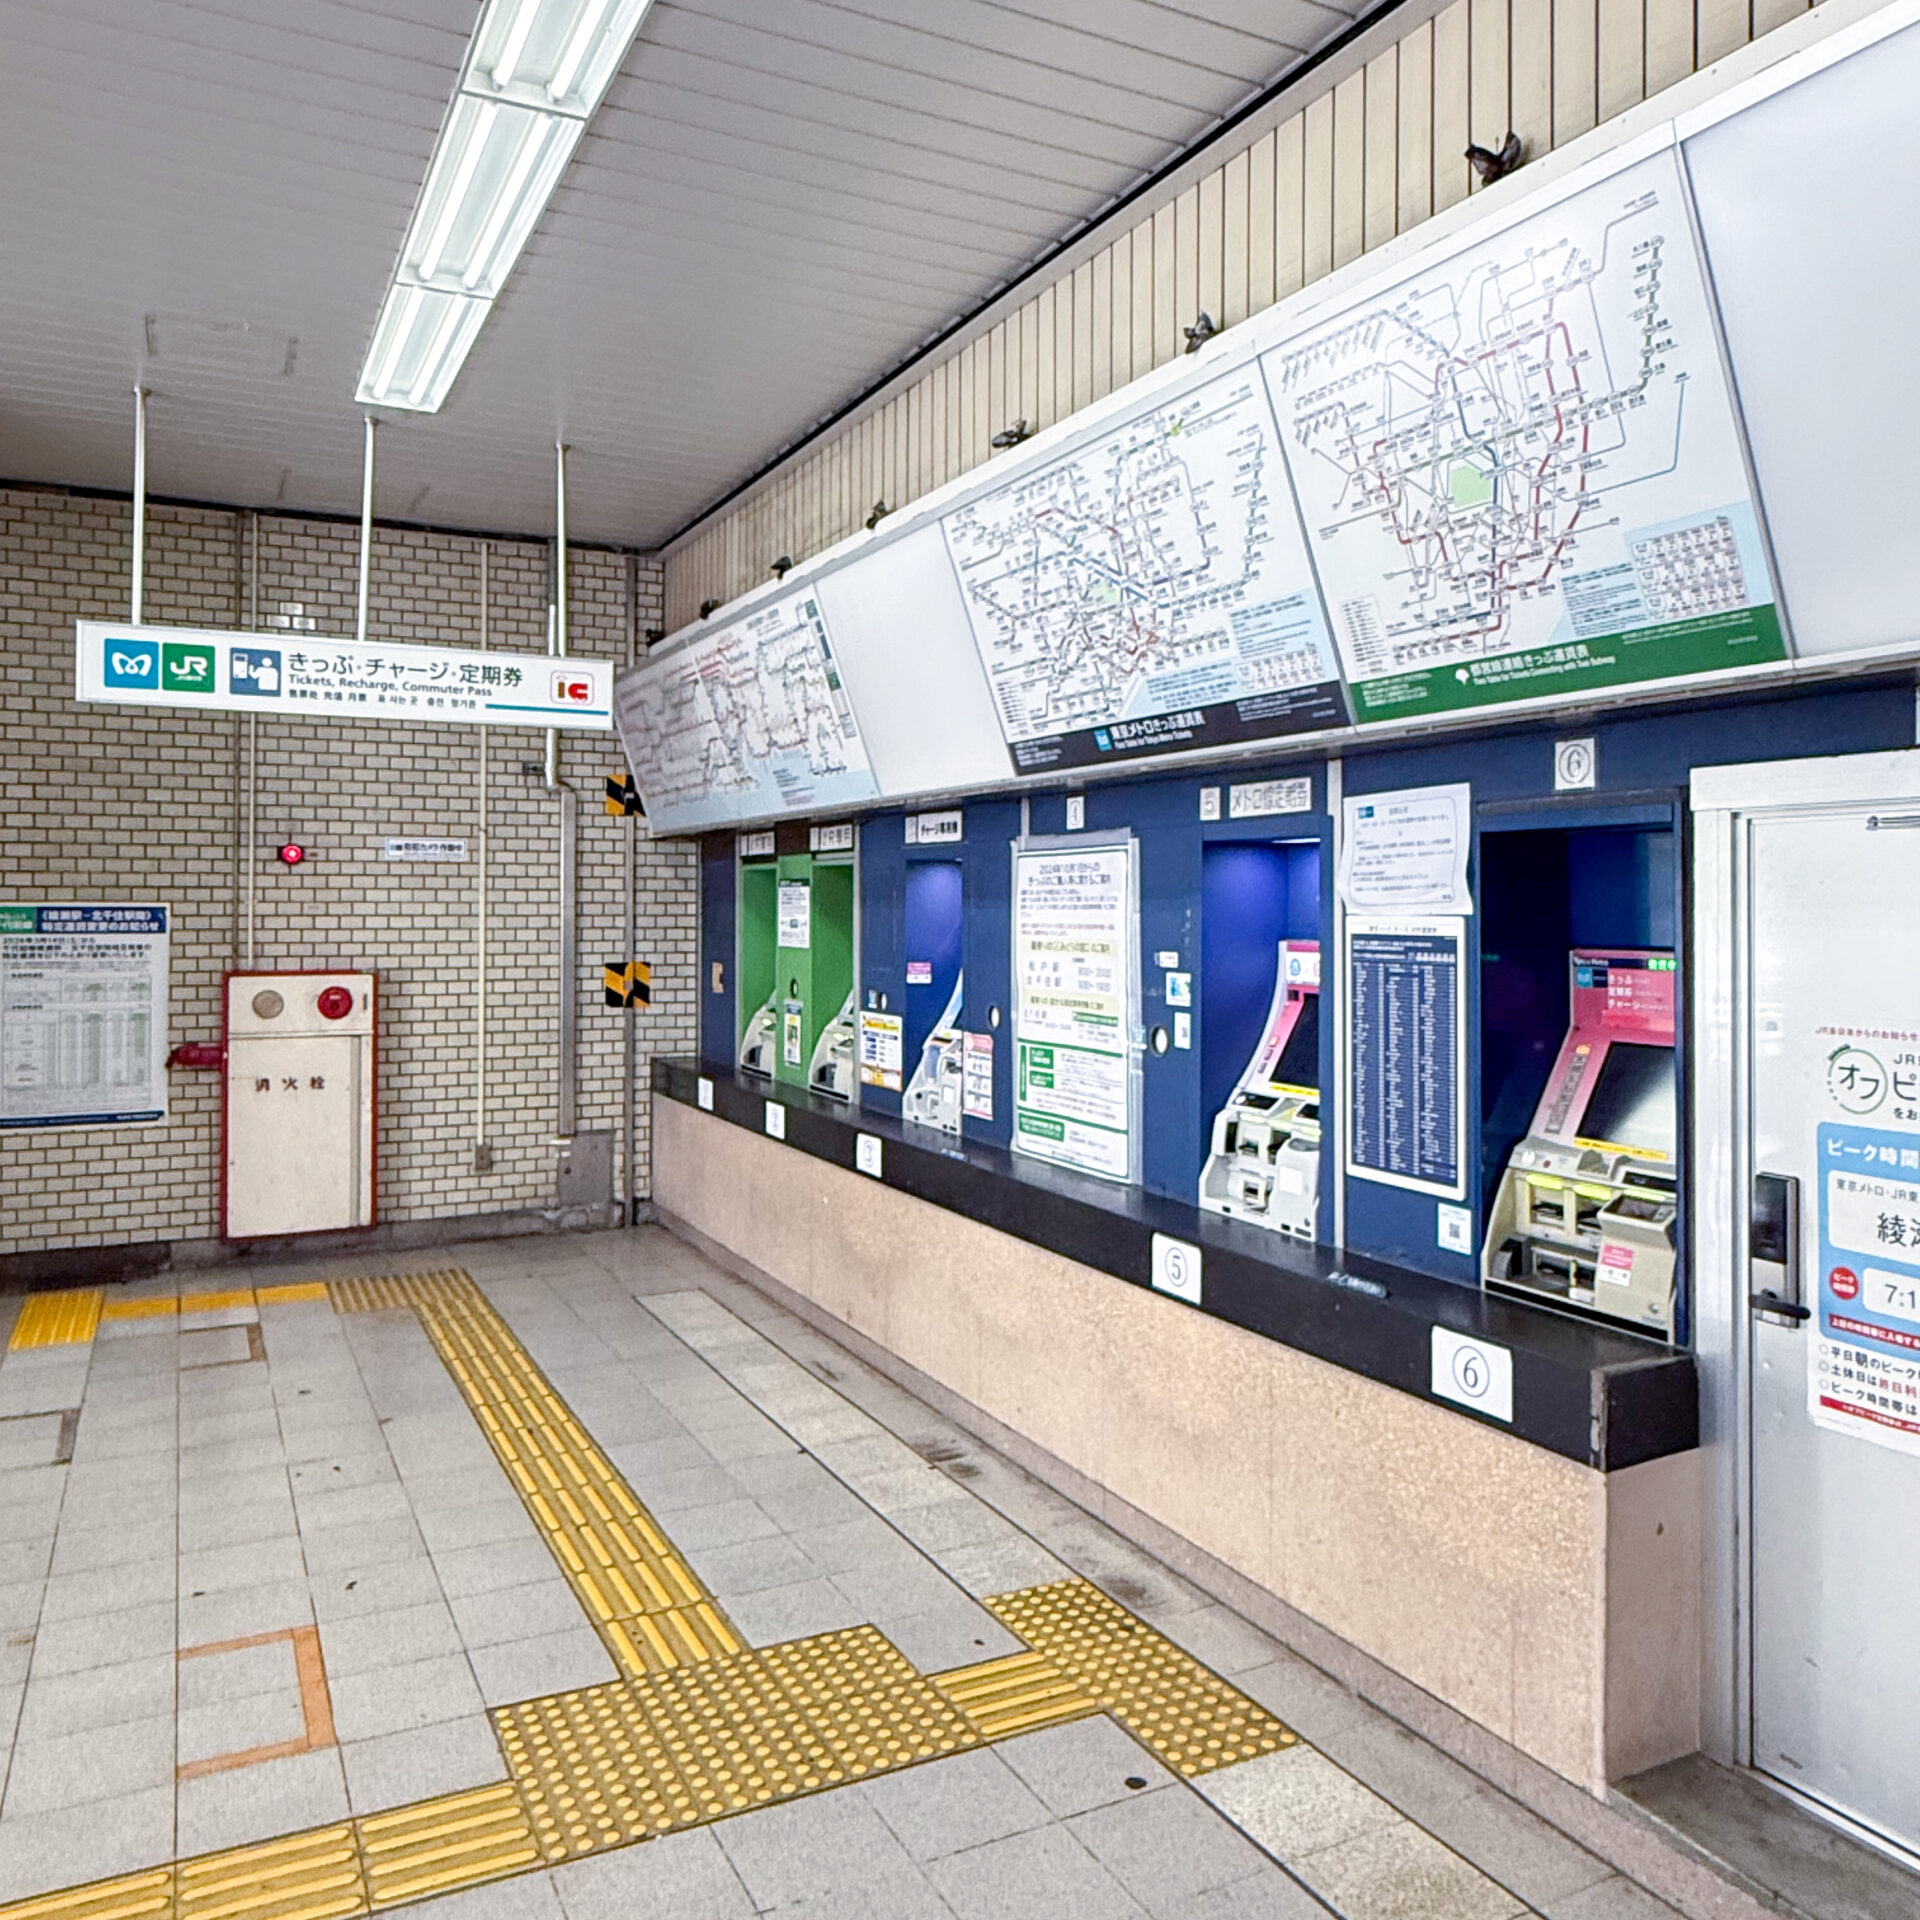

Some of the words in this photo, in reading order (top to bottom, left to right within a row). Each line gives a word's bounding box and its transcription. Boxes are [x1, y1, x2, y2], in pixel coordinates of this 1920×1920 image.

[170, 656, 208, 676] JR
[288, 652, 523, 688] きっぷ・チャージ・定期券
[288, 674, 335, 687] Tickets,
[340, 677, 399, 692] Recharge,
[402, 681, 464, 695] Commuter
[468, 686, 492, 696] Pass
[256, 1075, 325, 1093] 消火栓
[1838, 1064, 1880, 1100] オフ
